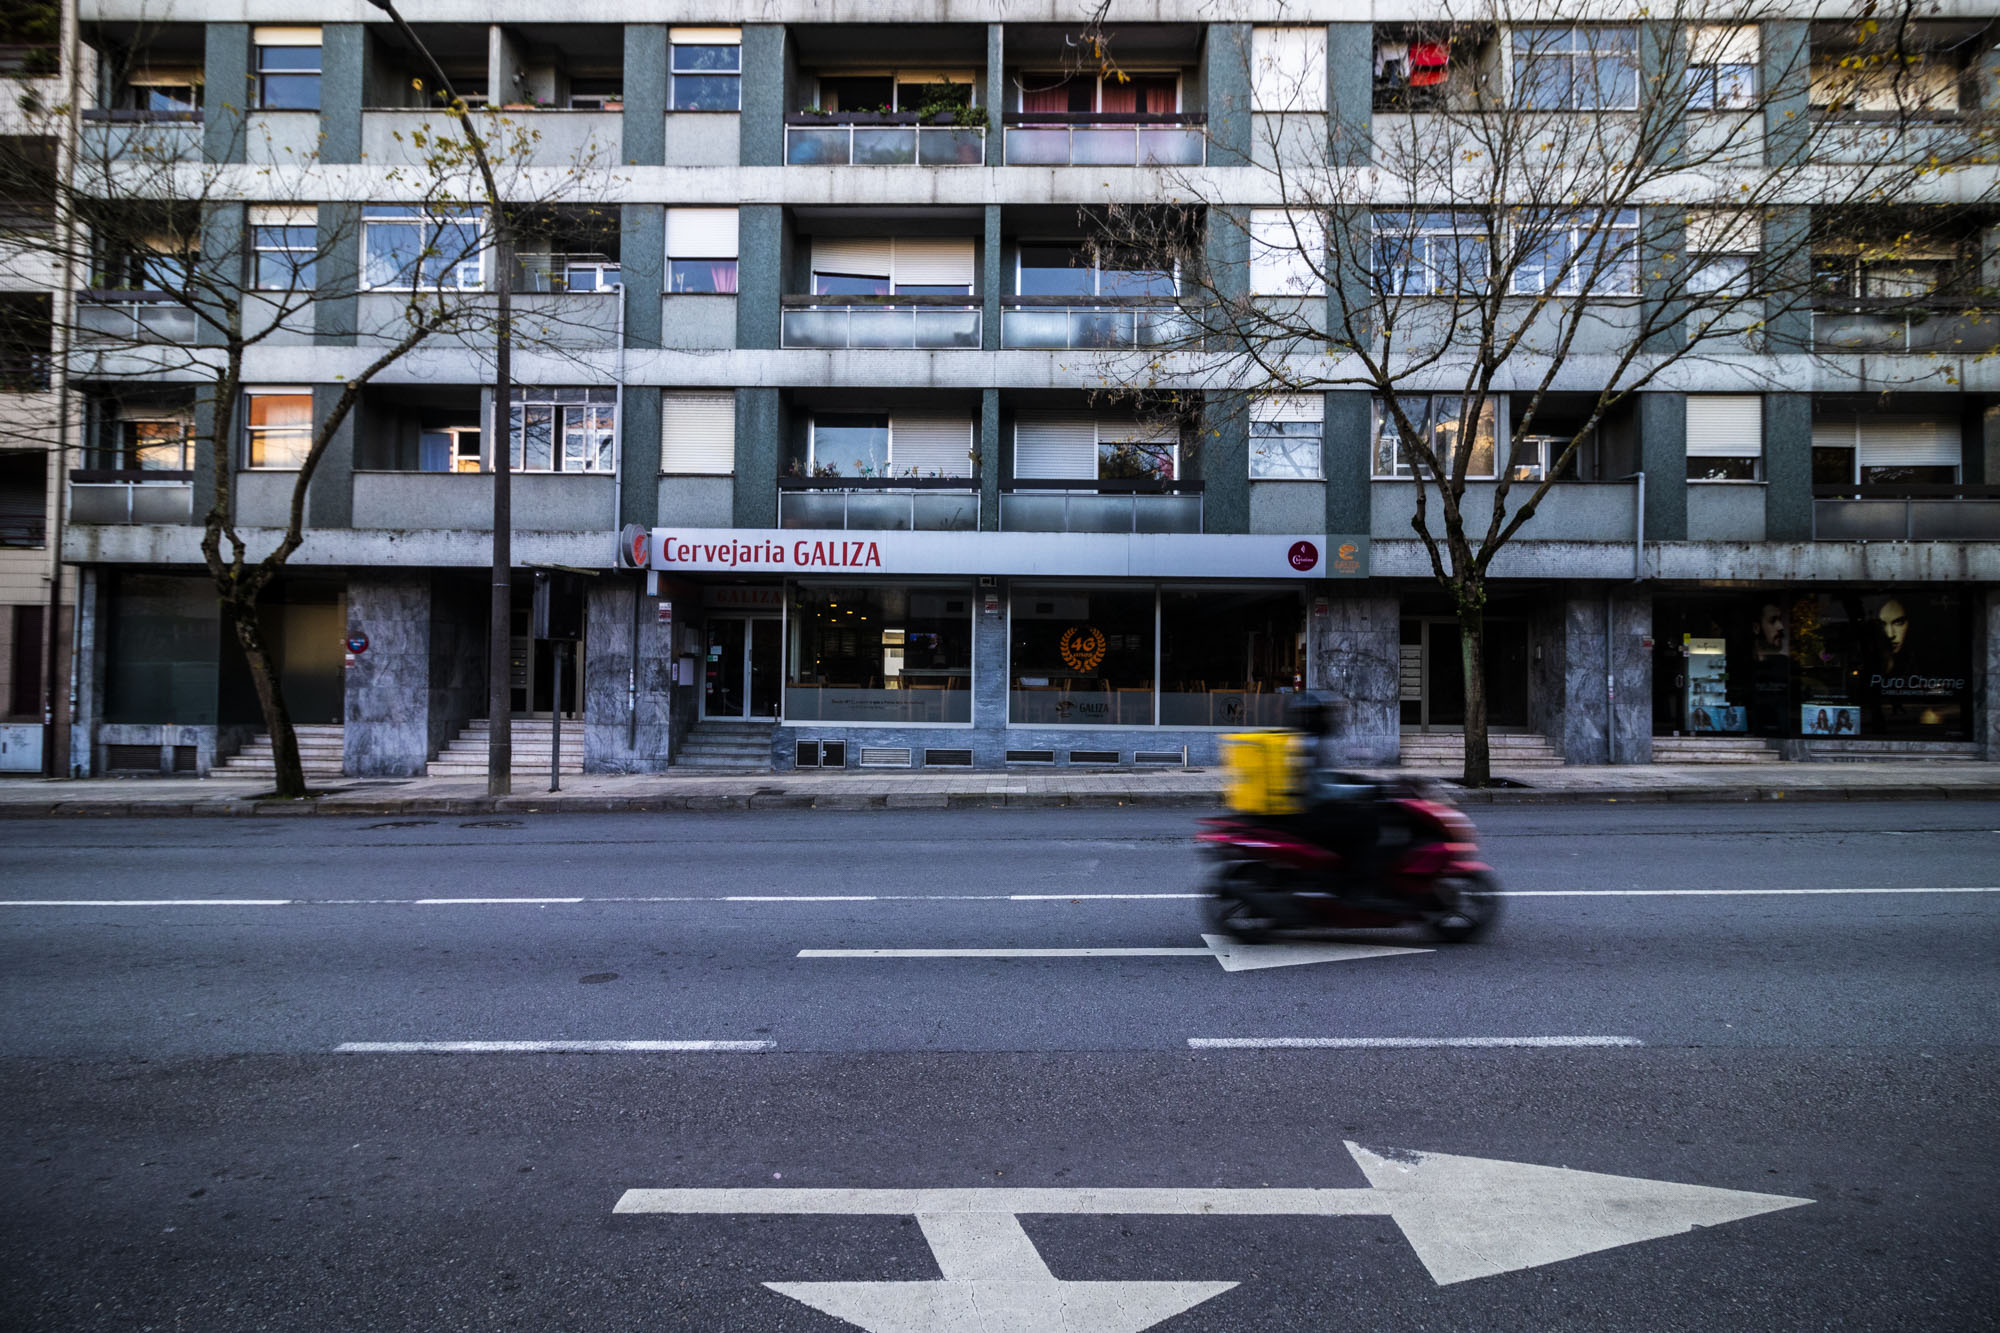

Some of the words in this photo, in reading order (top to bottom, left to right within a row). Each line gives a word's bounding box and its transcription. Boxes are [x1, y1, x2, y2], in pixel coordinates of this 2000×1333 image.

[663, 537, 785, 566] Cervejaria
[794, 541, 881, 567] GALIZA
[1870, 674, 1904, 688] Puro
[1909, 674, 1965, 689] Charme
[1079, 703, 1109, 712] GALIZA
